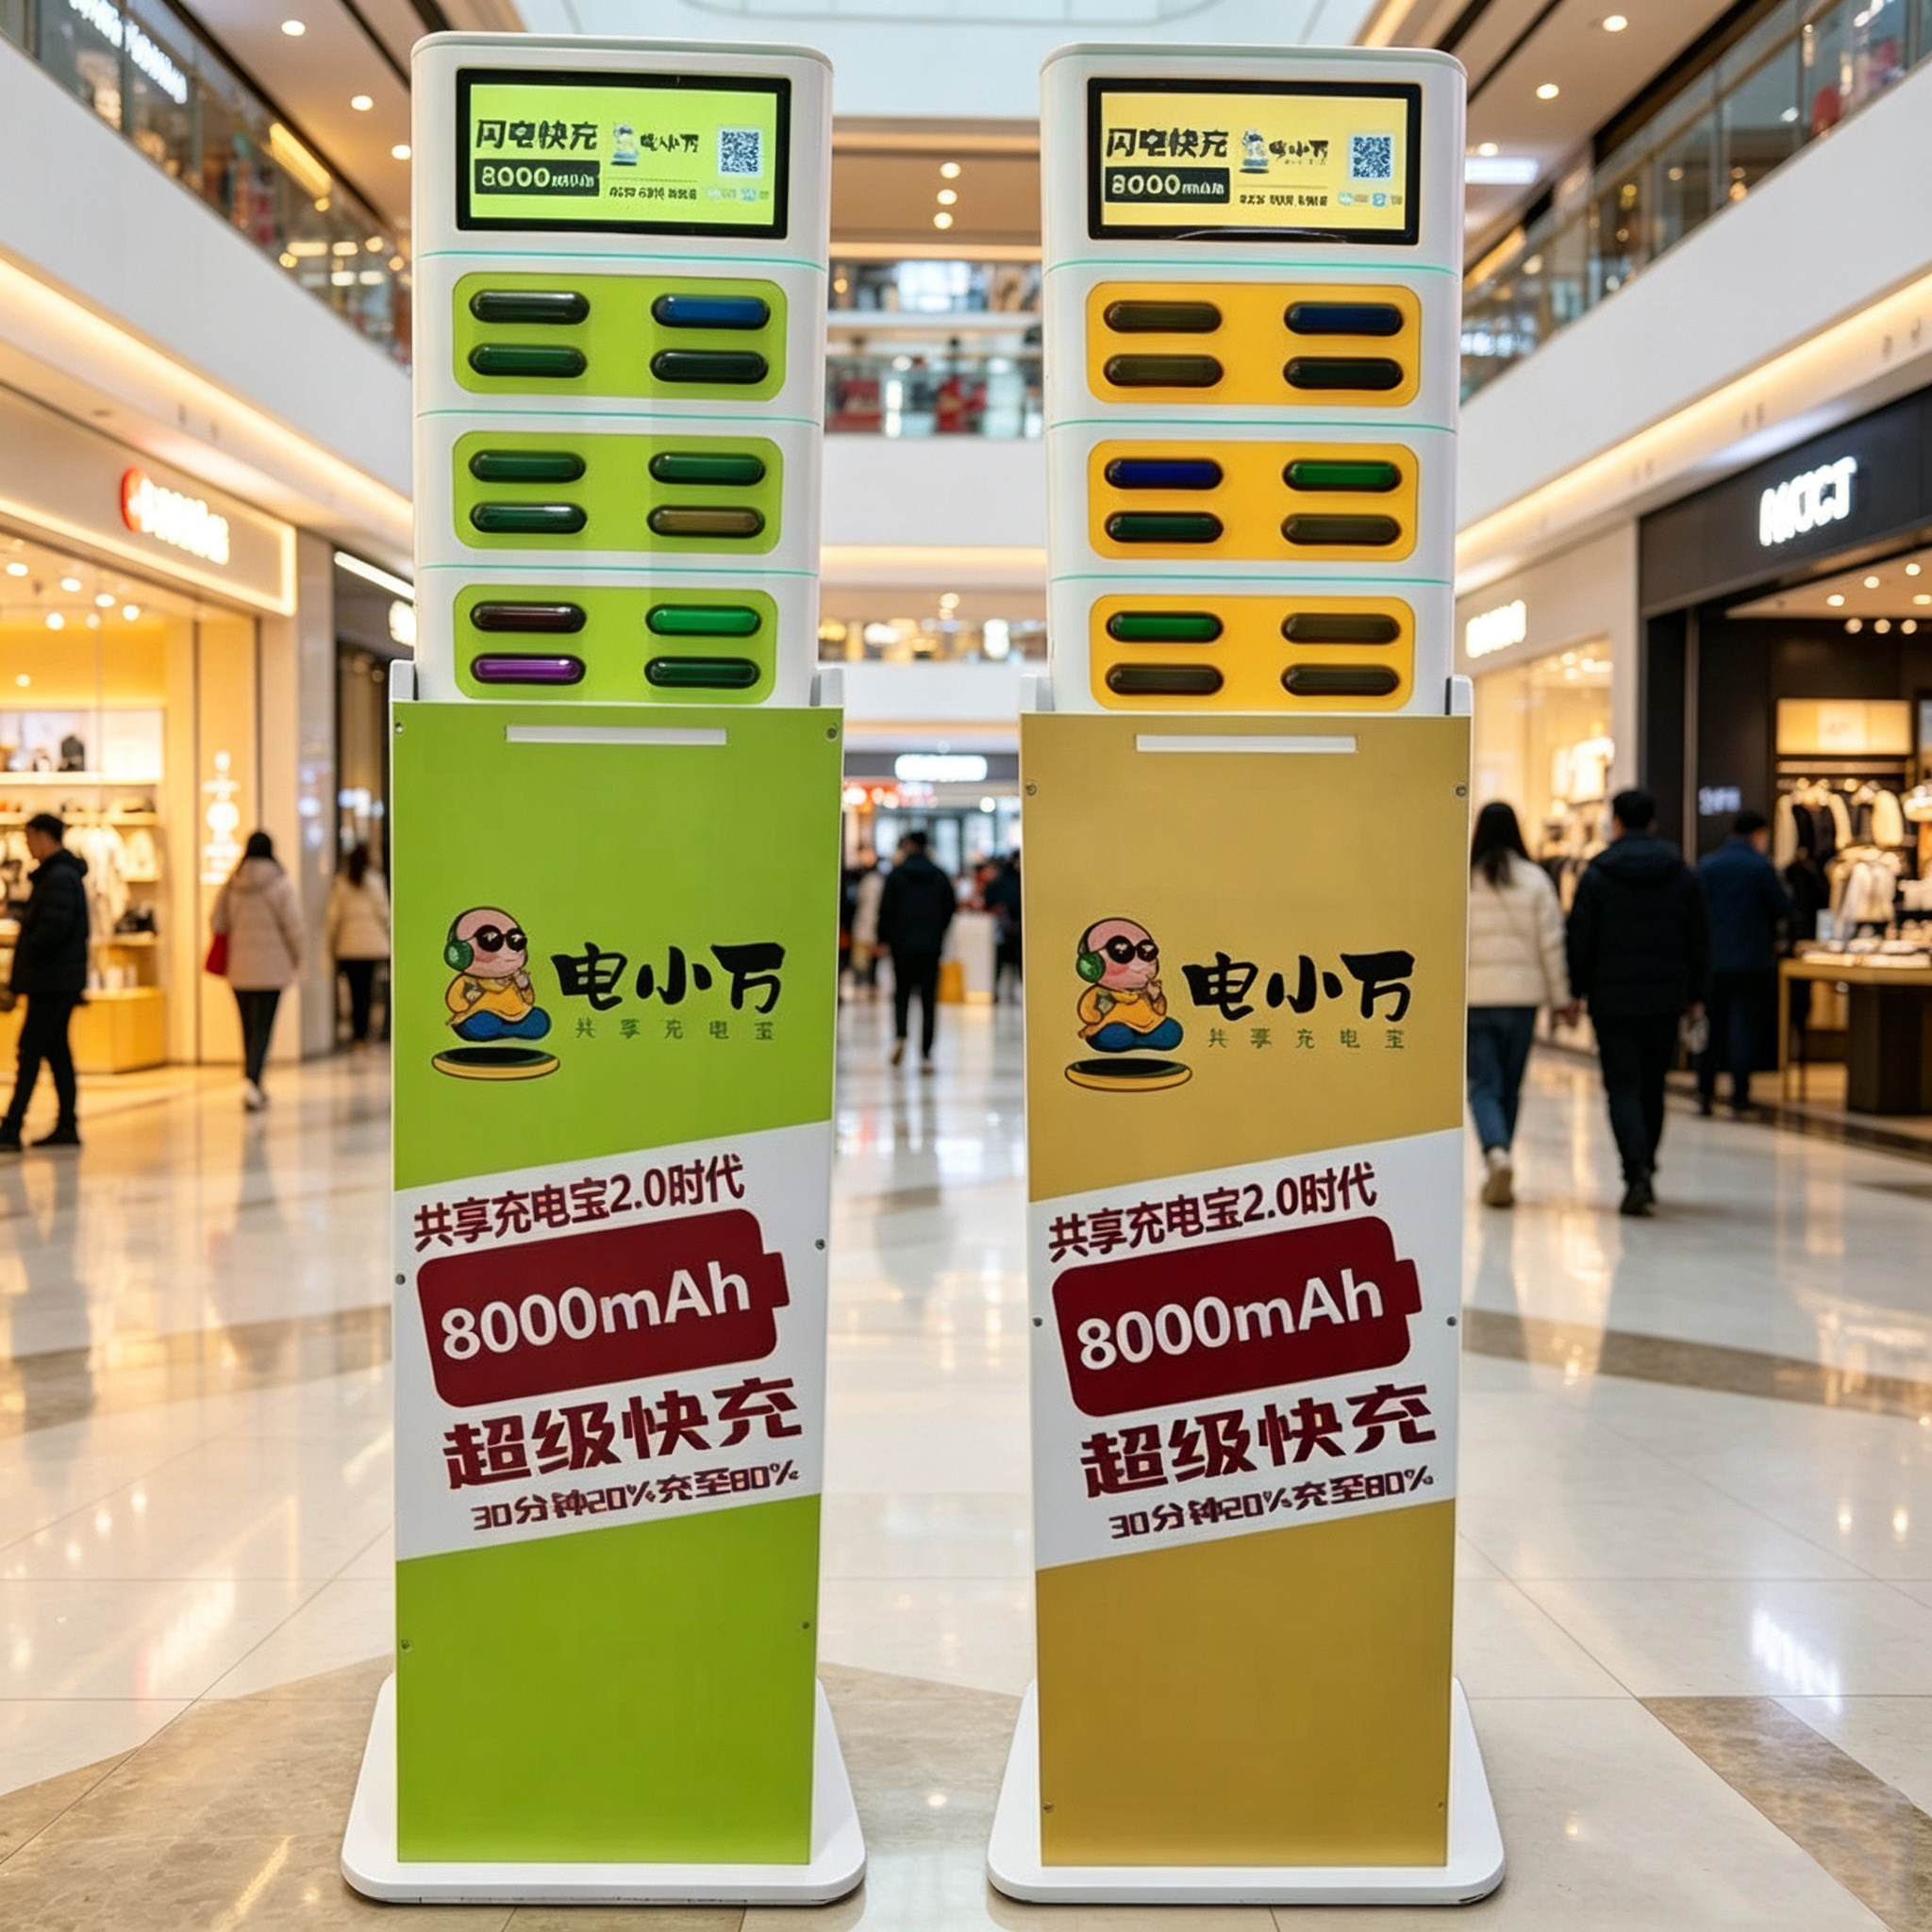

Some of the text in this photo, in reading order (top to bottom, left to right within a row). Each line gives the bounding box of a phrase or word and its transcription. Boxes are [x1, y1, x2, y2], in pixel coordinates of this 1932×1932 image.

[550, 941, 786, 1013] 电小万
[1181, 950, 1415, 1022] 电小万
[413, 1153, 745, 1252] 共享充电宝2.0时代
[1048, 1161, 1377, 1263] 共享充电宝2.0时代
[441, 1260, 751, 1360] 8000mAh
[1076, 1268, 1384, 1371] 8000mAh
[442, 1377, 802, 1490] 超级快充
[1080, 1384, 1437, 1498] 超级快充
[472, 1460, 800, 1530] 30分钟20%充至80%
[1109, 1465, 1434, 1540] 30分钟20%充至80%
